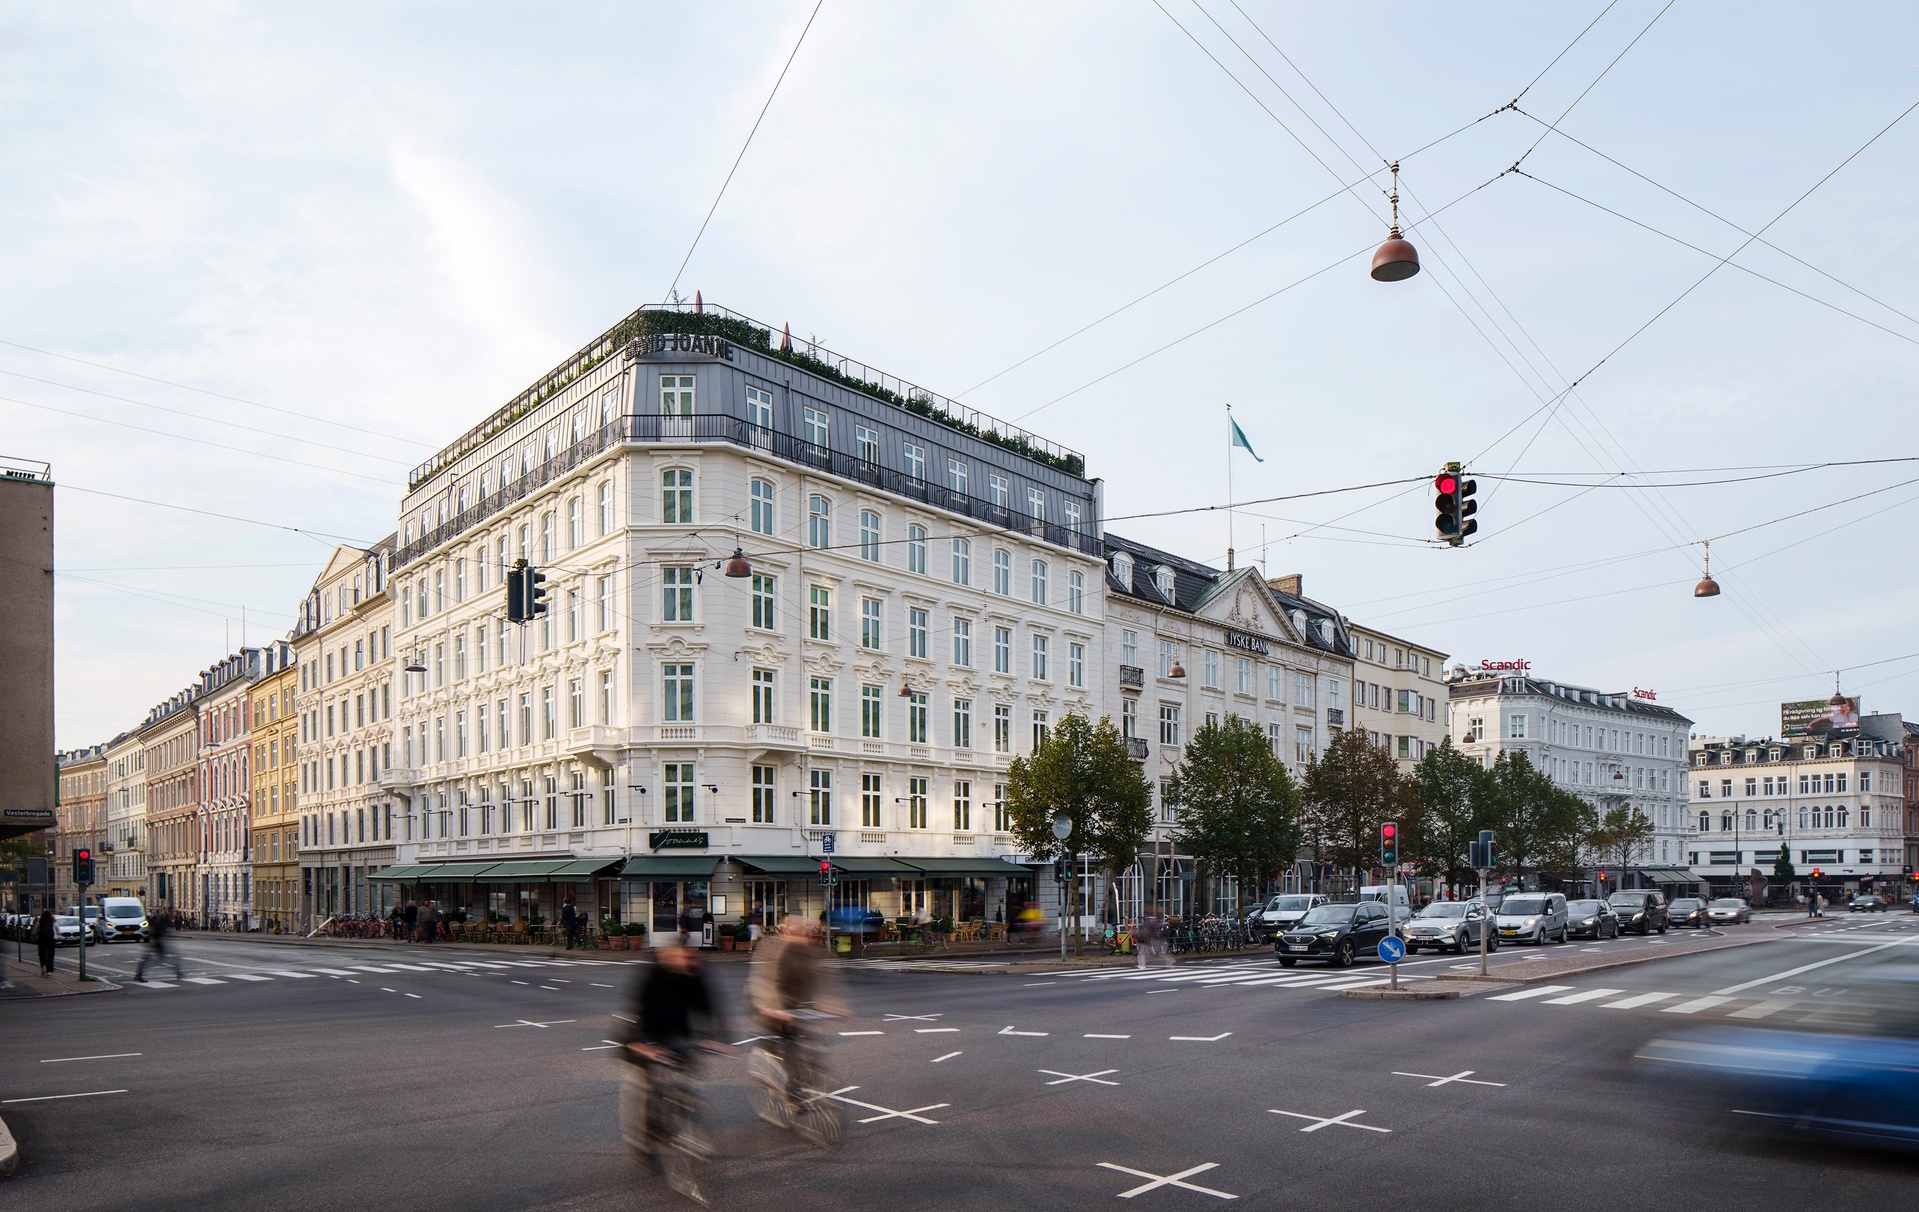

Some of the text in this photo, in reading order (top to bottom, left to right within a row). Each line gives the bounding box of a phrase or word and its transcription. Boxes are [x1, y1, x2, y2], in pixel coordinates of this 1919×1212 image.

[1230, 632, 1270, 653] JYSKE BANK
[1481, 658, 1531, 671] Scandic
[1633, 686, 1657, 701] Scandic
[653, 829, 704, 852] Joanne's
